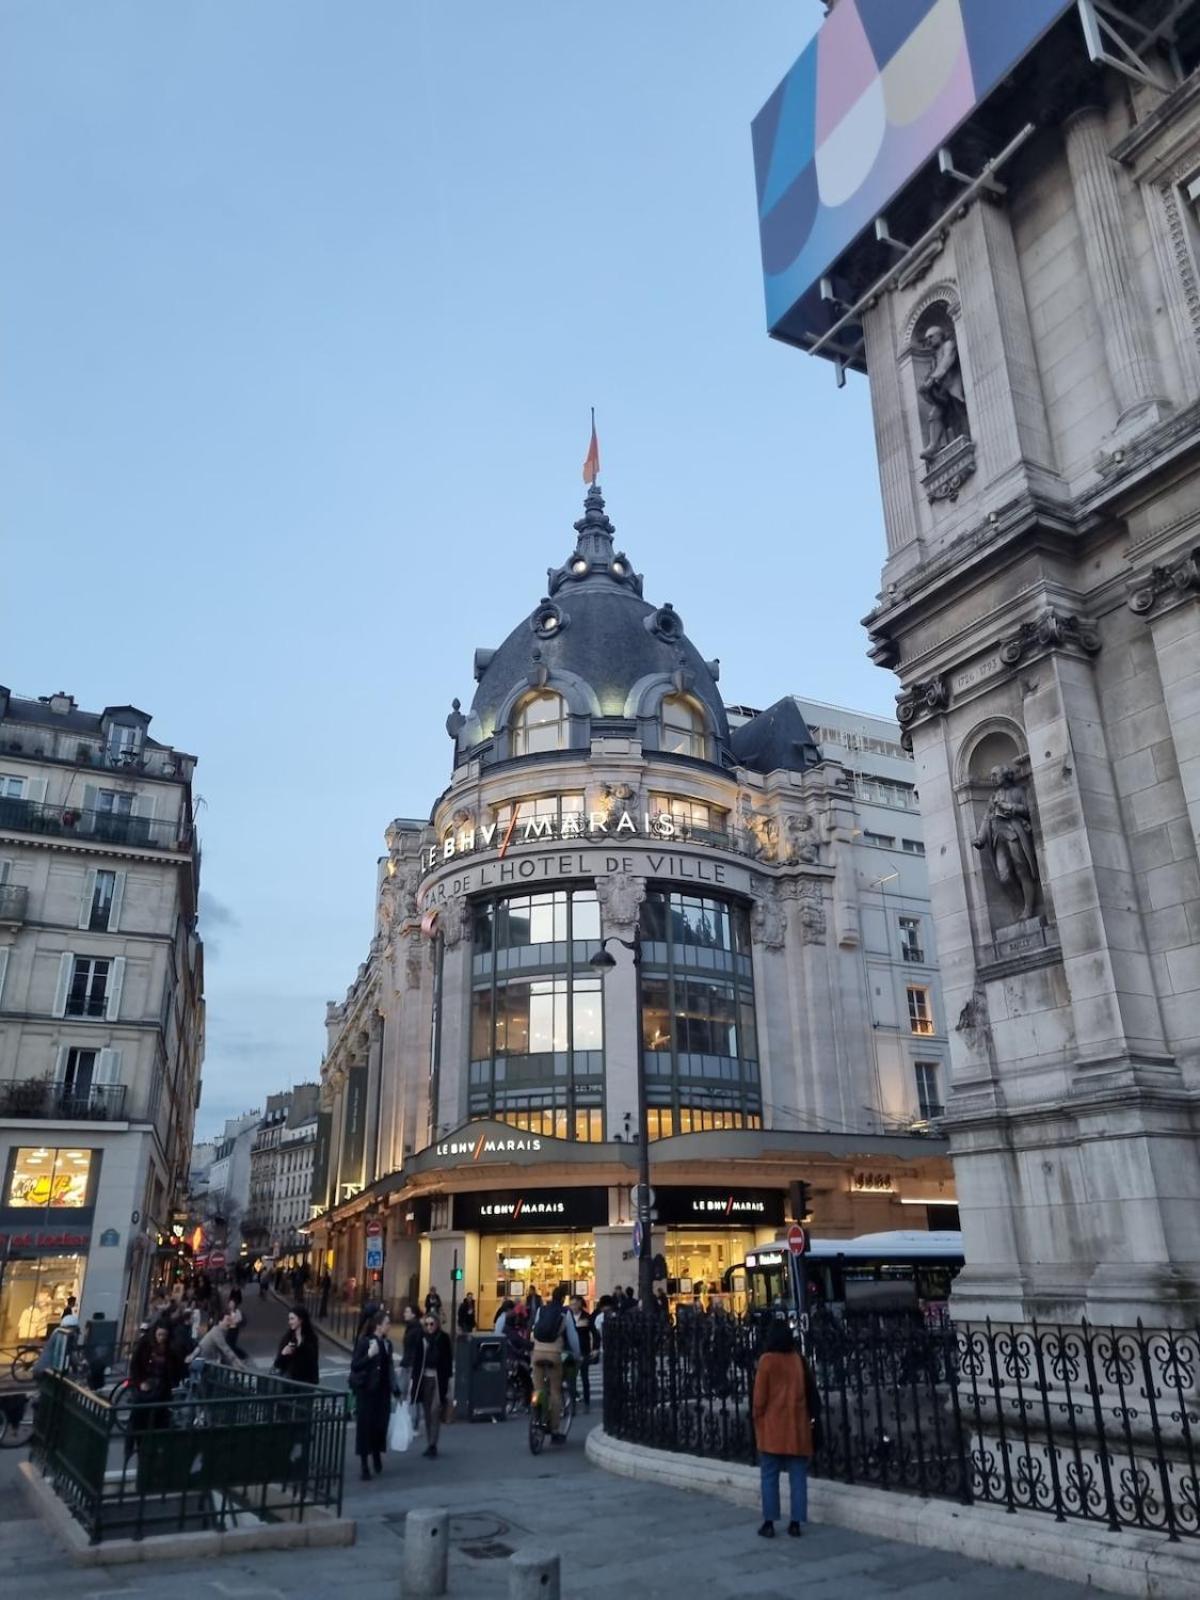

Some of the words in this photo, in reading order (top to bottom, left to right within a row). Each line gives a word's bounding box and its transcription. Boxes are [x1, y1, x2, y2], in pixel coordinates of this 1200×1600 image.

[421, 845, 437, 874] LE
[453, 875, 471, 895] DE
[481, 854, 592, 886] L'HOTEL
[605, 857, 633, 873] DE
[646, 854, 725, 884] VILLE
[436, 1143, 449, 1156] LE
[480, 1204, 493, 1216] LE
[692, 1200, 705, 1211] LE
